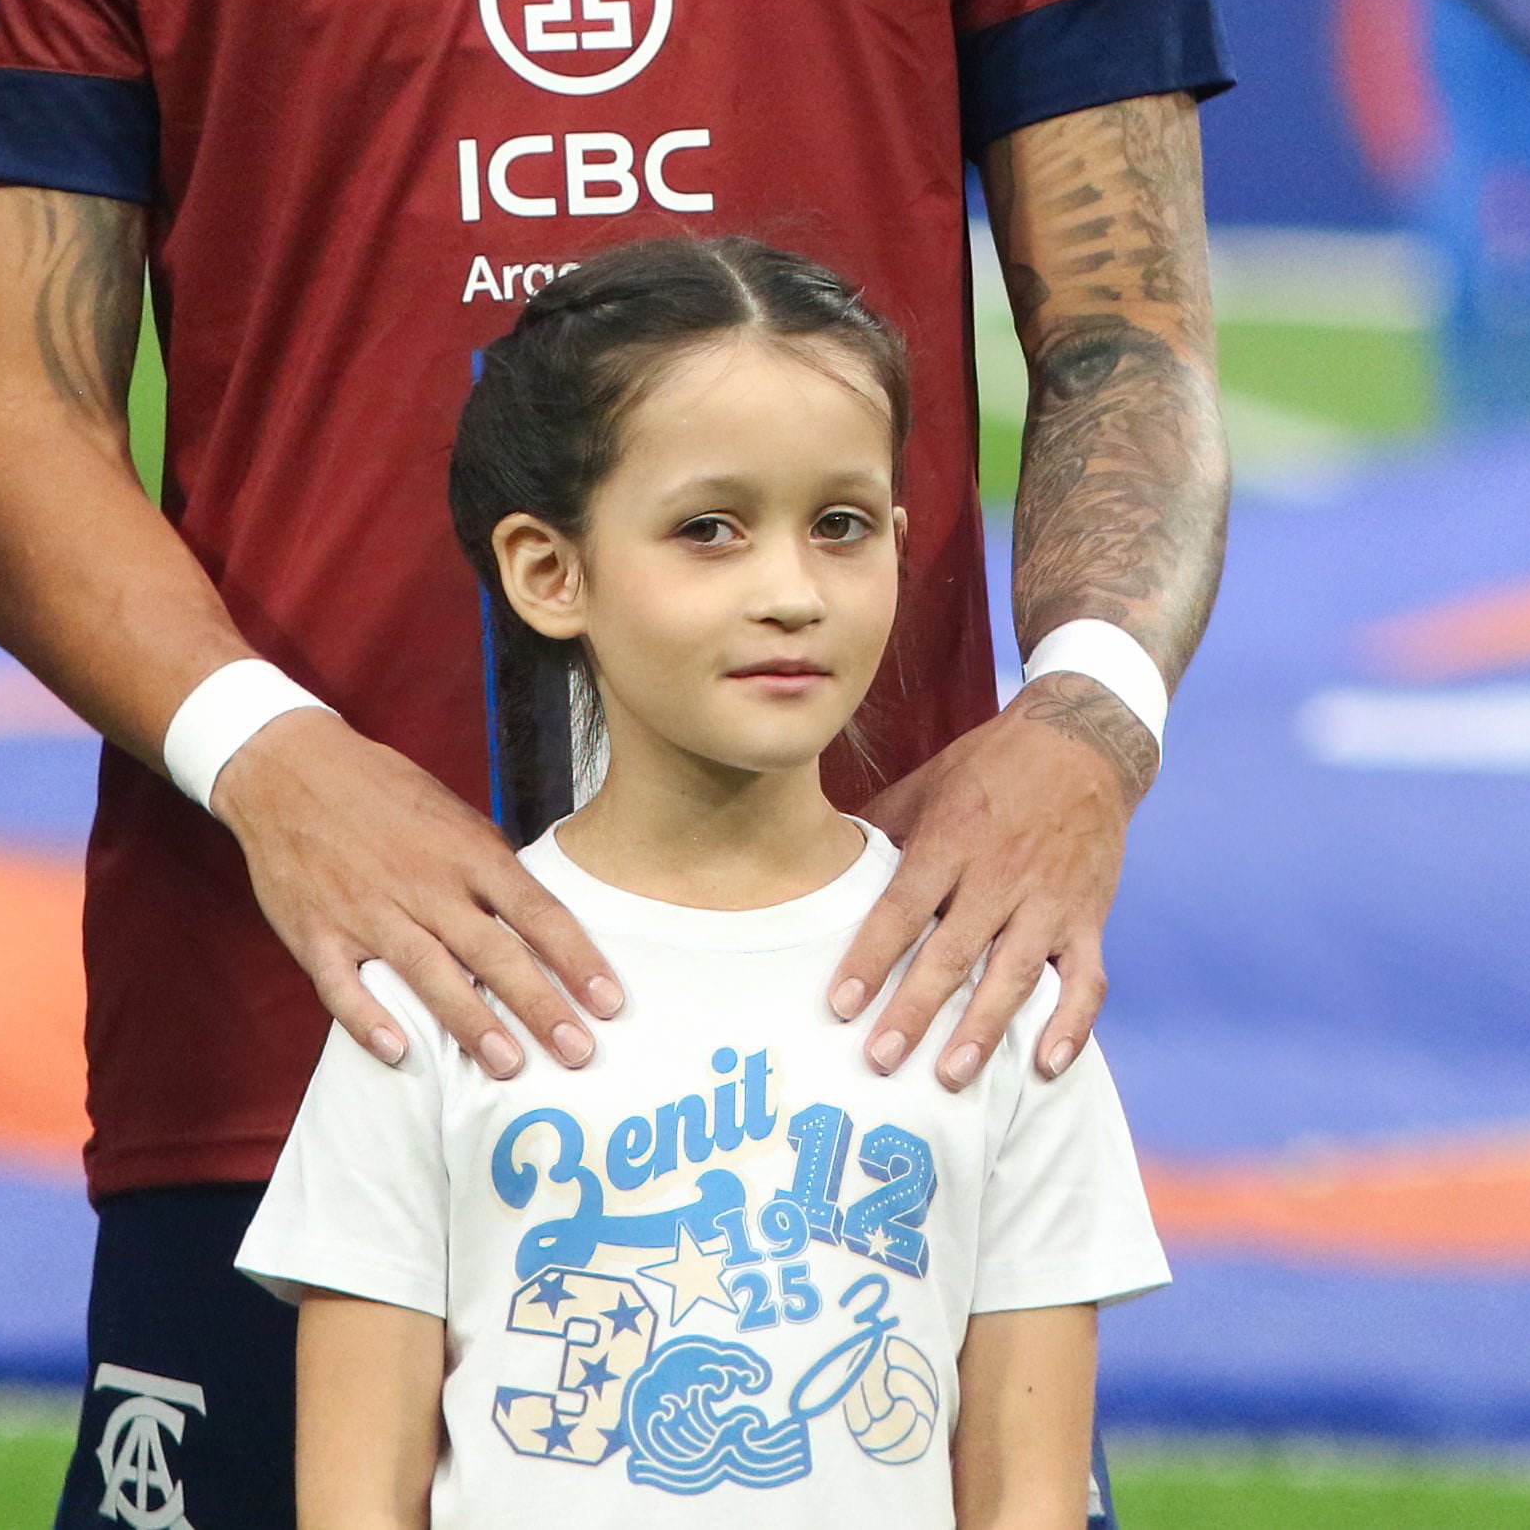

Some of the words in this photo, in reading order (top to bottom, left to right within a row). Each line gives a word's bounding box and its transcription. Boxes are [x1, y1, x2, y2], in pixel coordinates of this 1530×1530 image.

[458, 128, 715, 222] ICBC
[462, 255, 582, 304] Arg
[774, 1102, 938, 1280] 12
[713, 1198, 812, 1270] 19
[731, 1260, 823, 1334] 25
